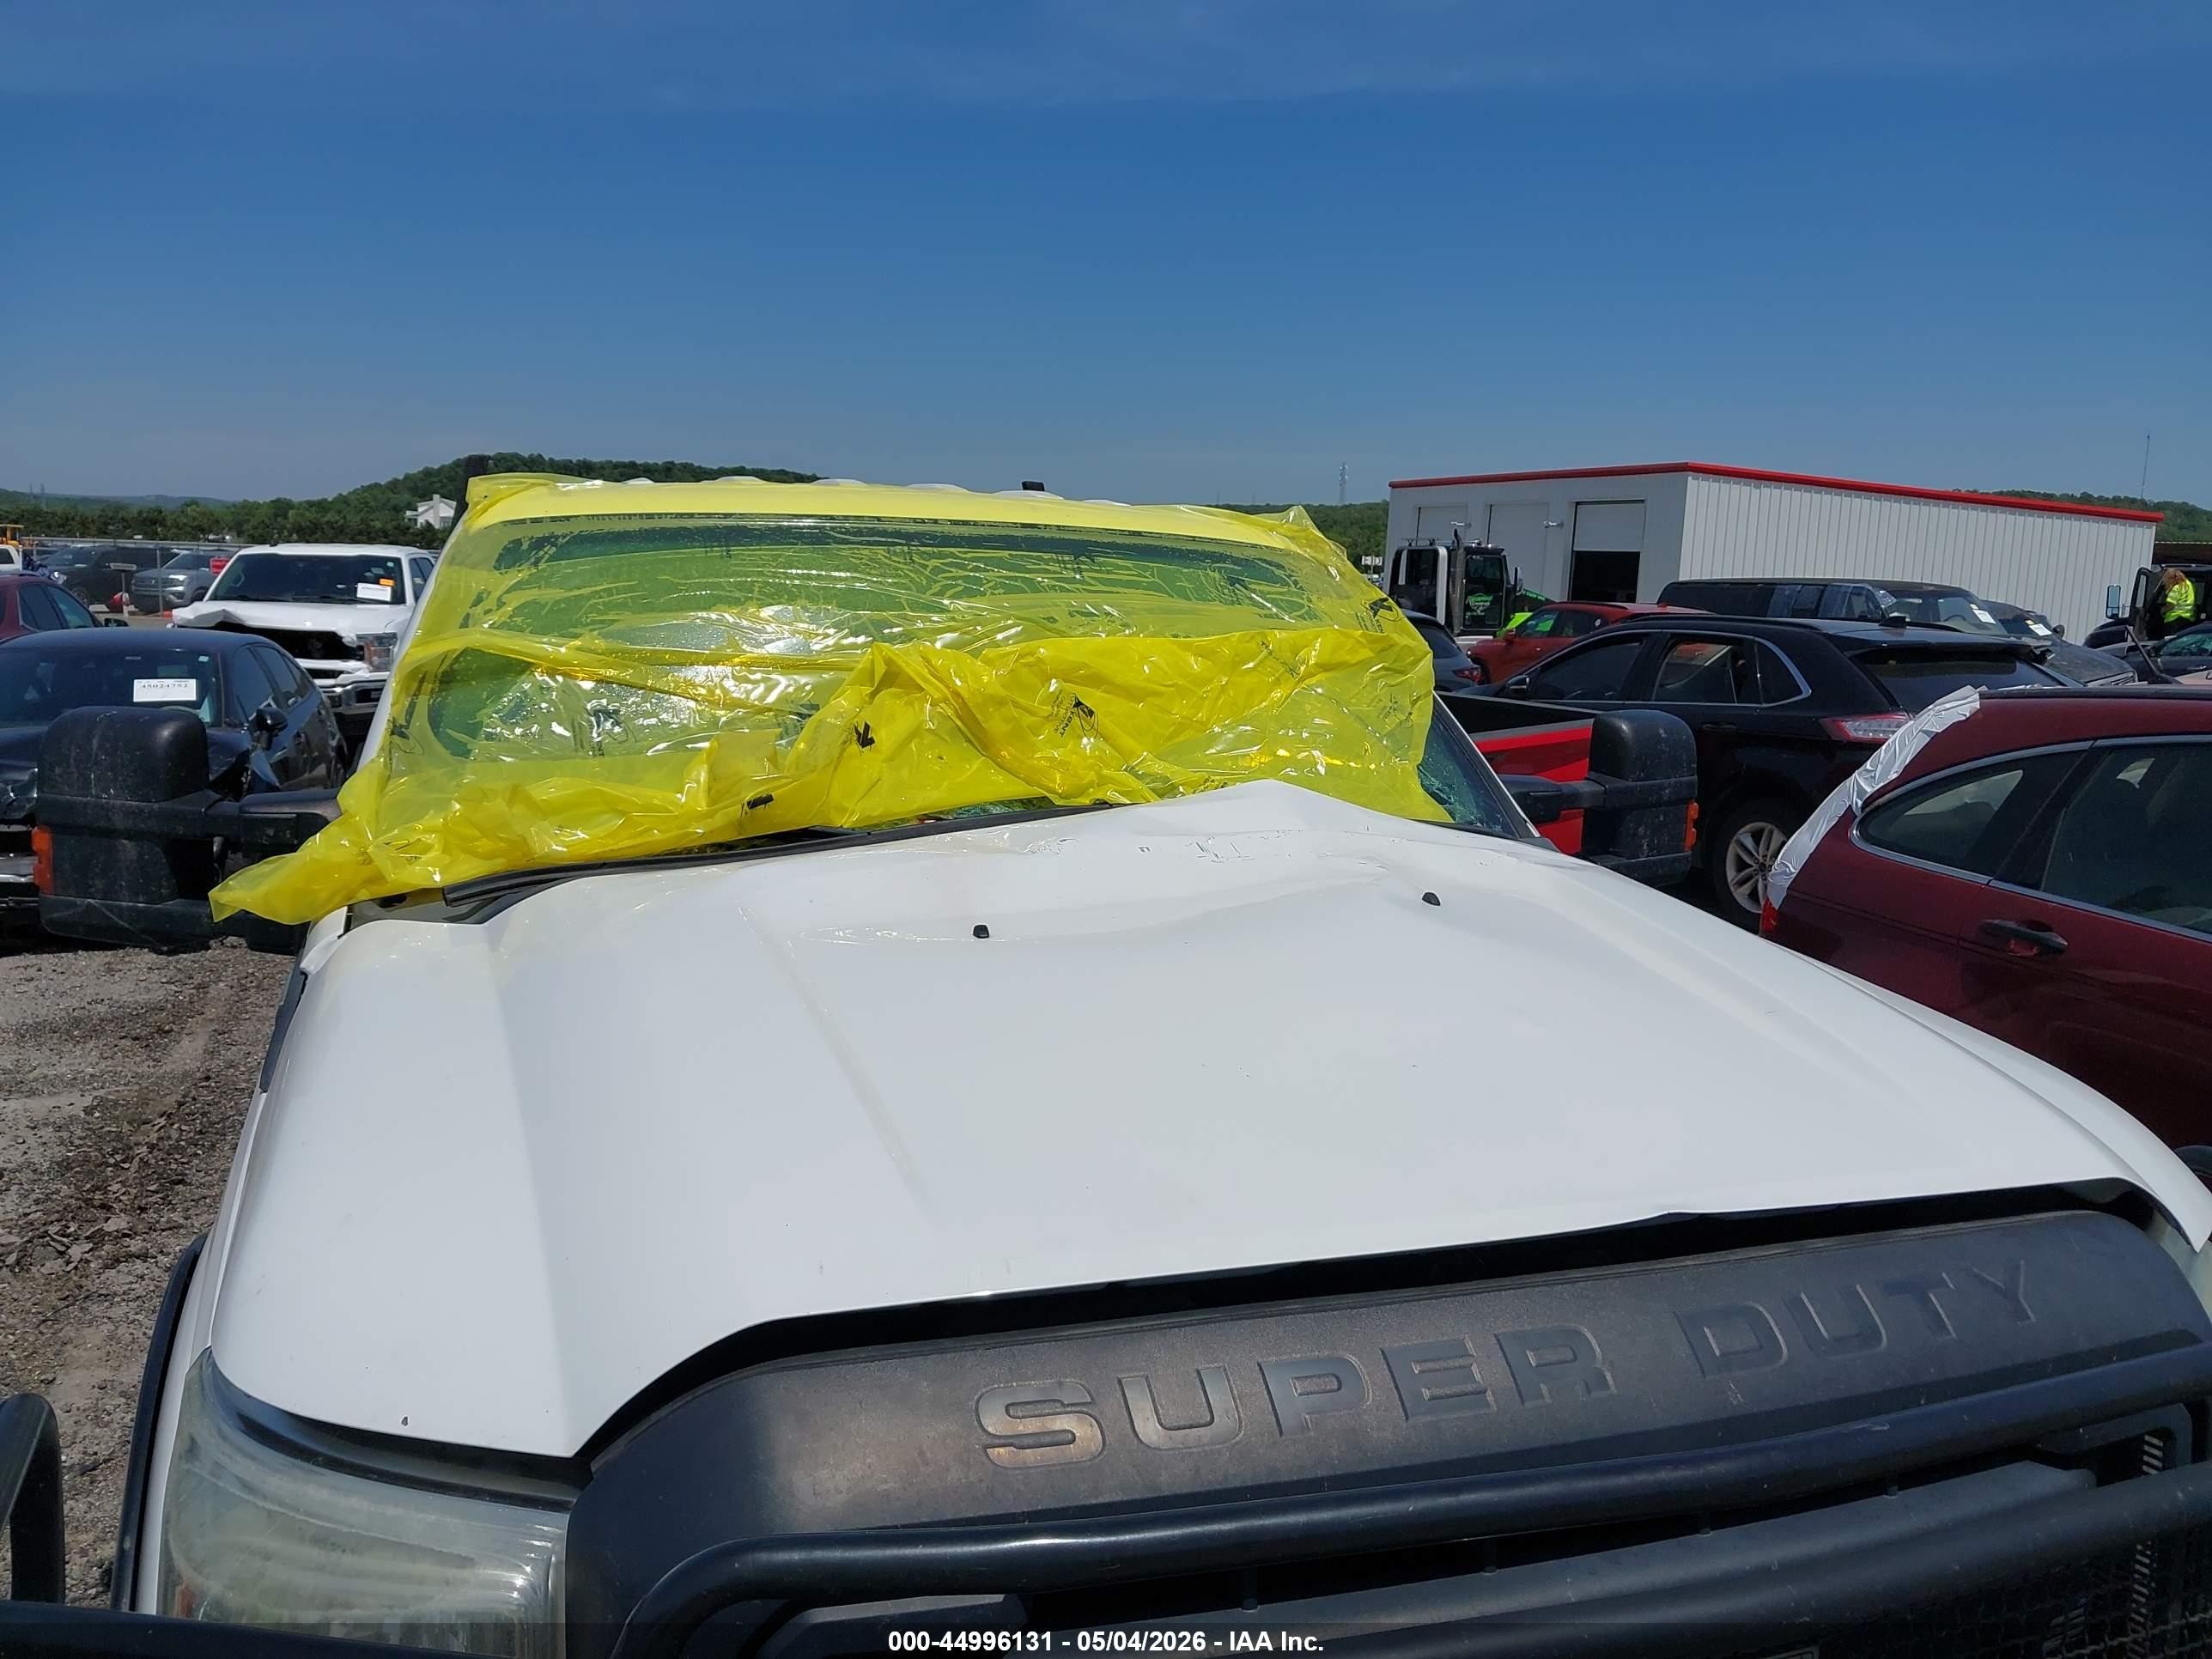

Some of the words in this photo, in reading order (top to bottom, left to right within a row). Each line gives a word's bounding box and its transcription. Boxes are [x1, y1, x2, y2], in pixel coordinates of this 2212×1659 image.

[1059, 711, 1075, 738] KENT
[974, 1324, 1617, 1469] SUPER
[1673, 1259, 2037, 1379] DUTY
